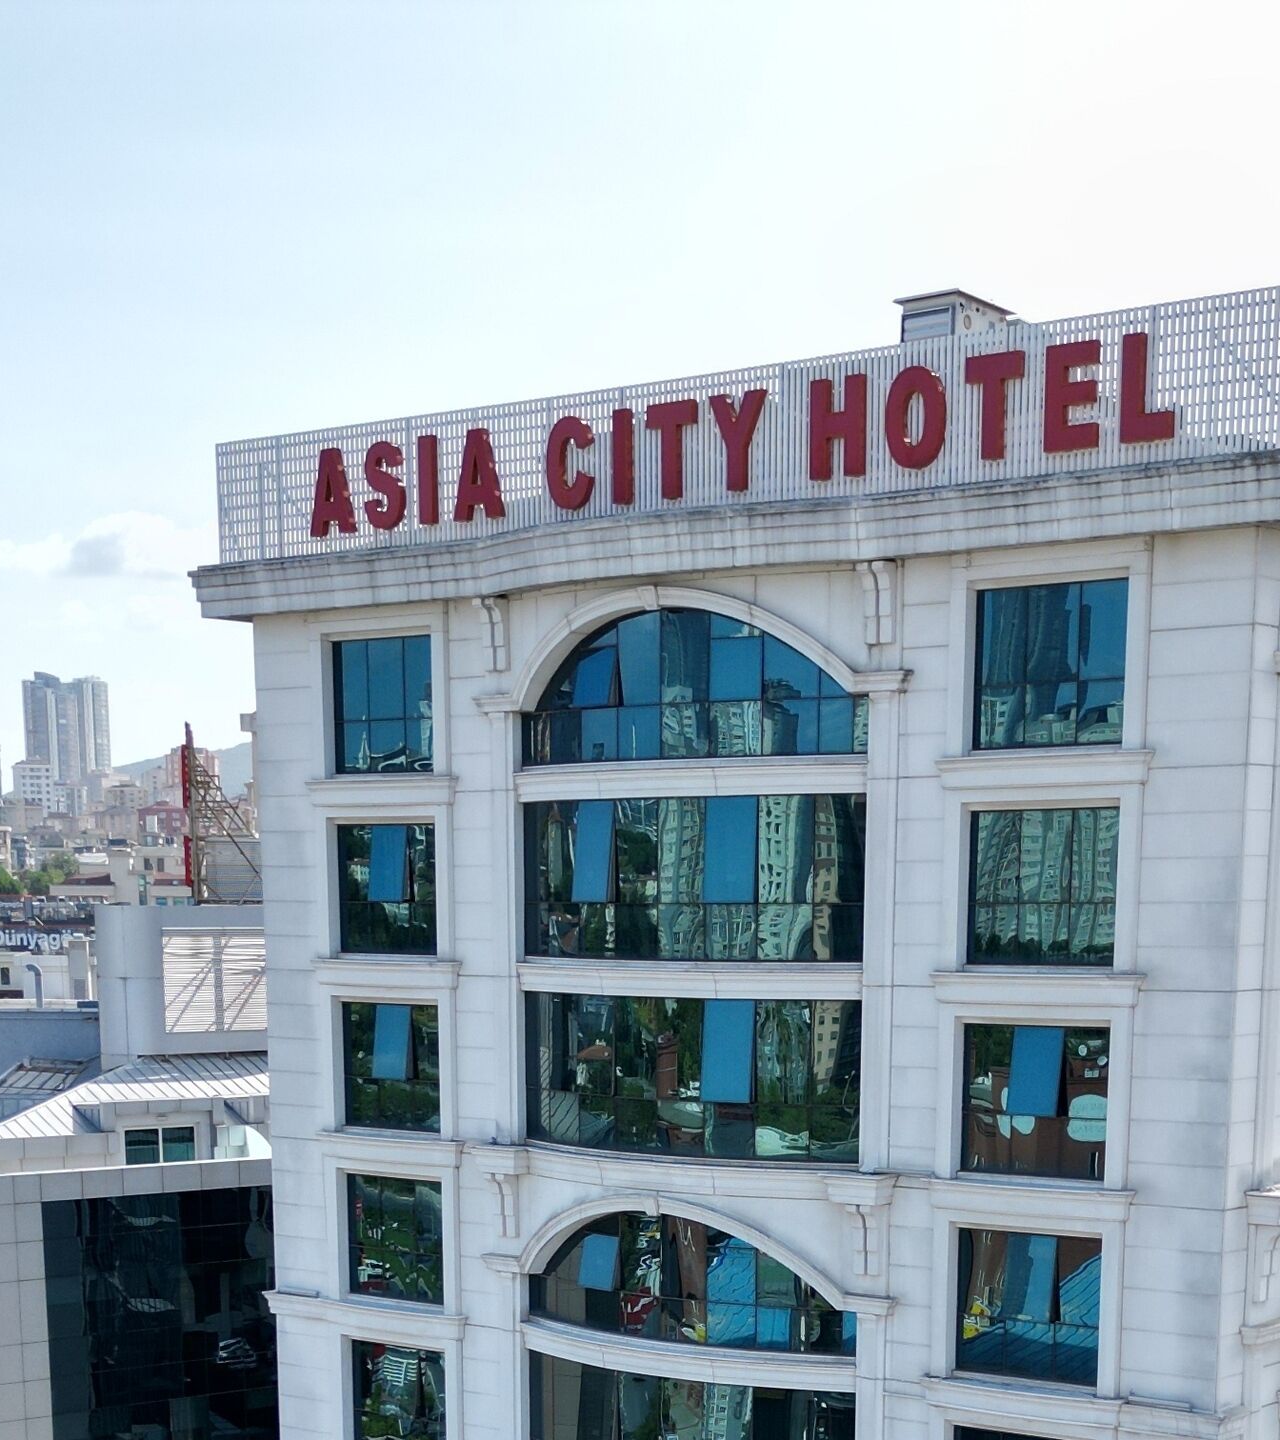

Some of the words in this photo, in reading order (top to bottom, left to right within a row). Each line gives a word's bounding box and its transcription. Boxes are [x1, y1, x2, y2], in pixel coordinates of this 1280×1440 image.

[310, 428, 506, 538] ASIA
[546, 389, 767, 510] CITY
[809, 332, 1175, 481] HOTEL
